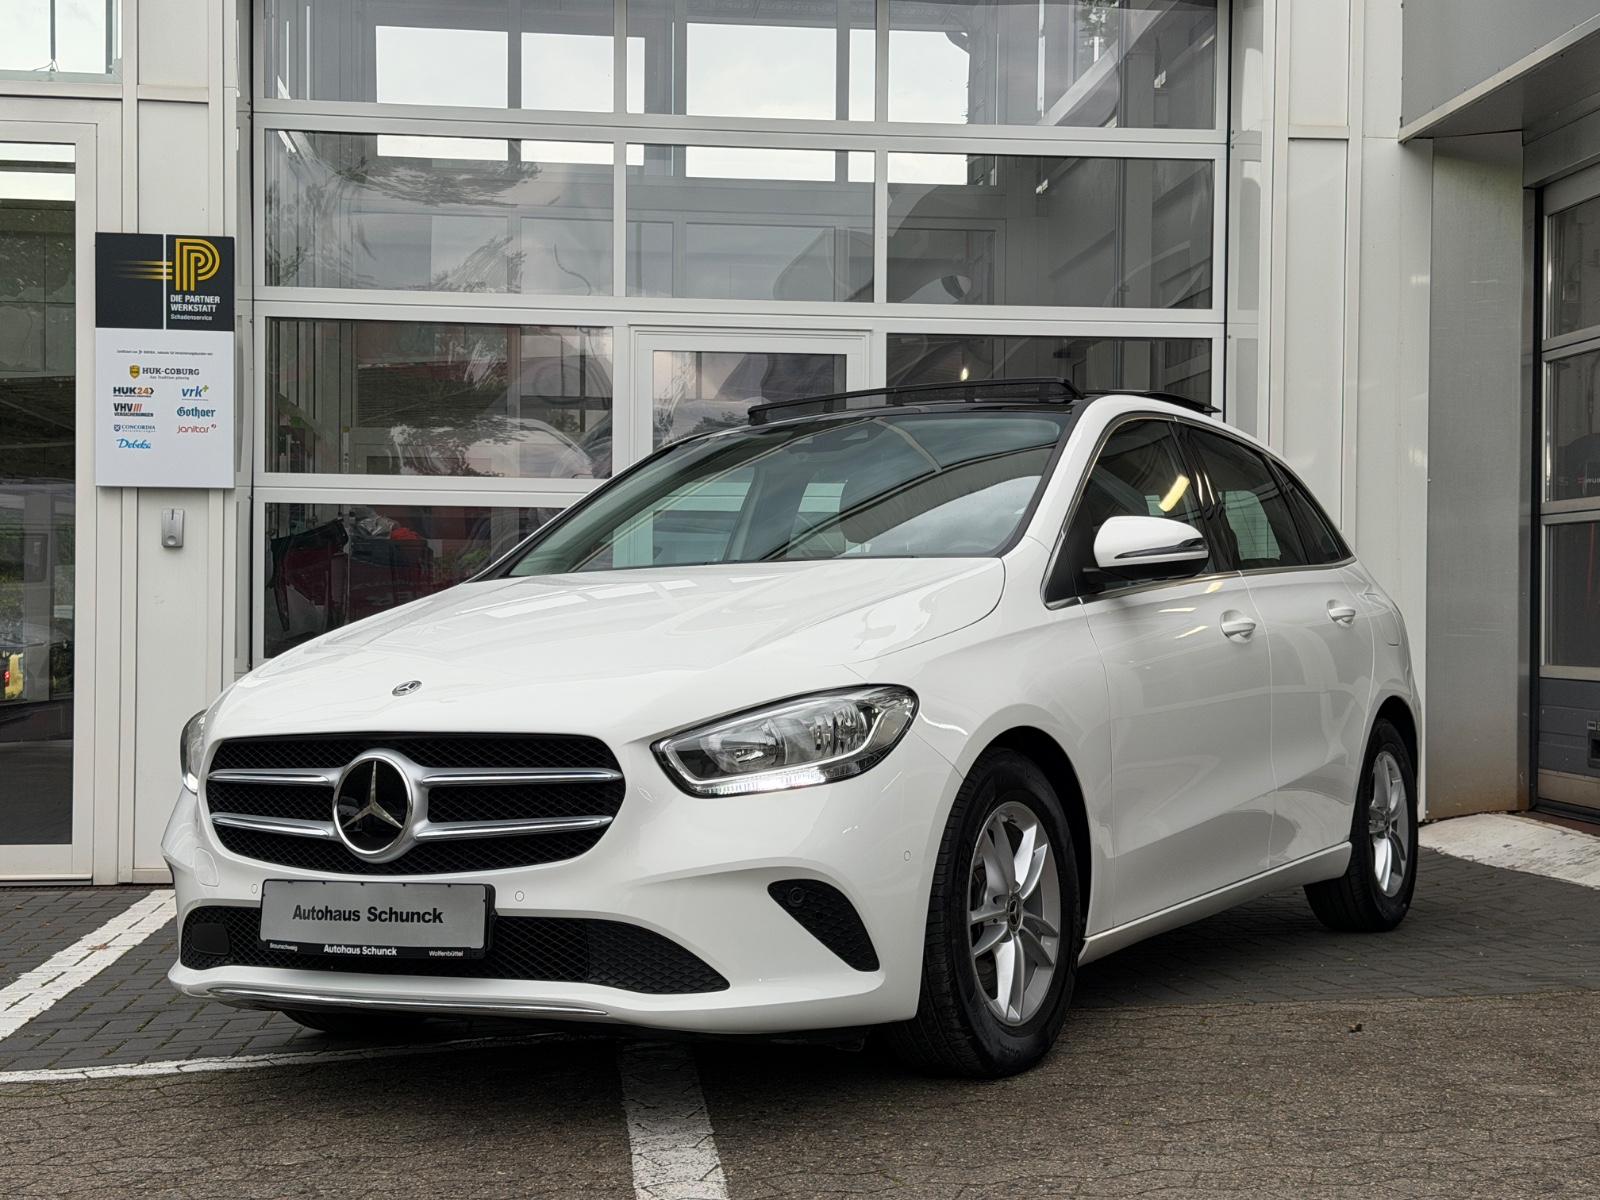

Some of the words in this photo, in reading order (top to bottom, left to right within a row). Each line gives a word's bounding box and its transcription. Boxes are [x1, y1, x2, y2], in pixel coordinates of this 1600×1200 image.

[170, 294, 183, 303] DIE
[185, 295, 221, 304] PARTNER
[170, 303, 217, 312] WERKSTATT
[170, 313, 213, 321] Schadenservice
[142, 367, 200, 376] HUK-COBURG
[113, 386, 150, 395] HUK24
[176, 406, 216, 419] Gothaer
[292, 904, 361, 922] Autohaus
[367, 906, 444, 924] Schunck
[323, 944, 361, 955] Autohaus
[361, 946, 397, 956] Schunck
[429, 950, 464, 958] Wolfenbüttel
